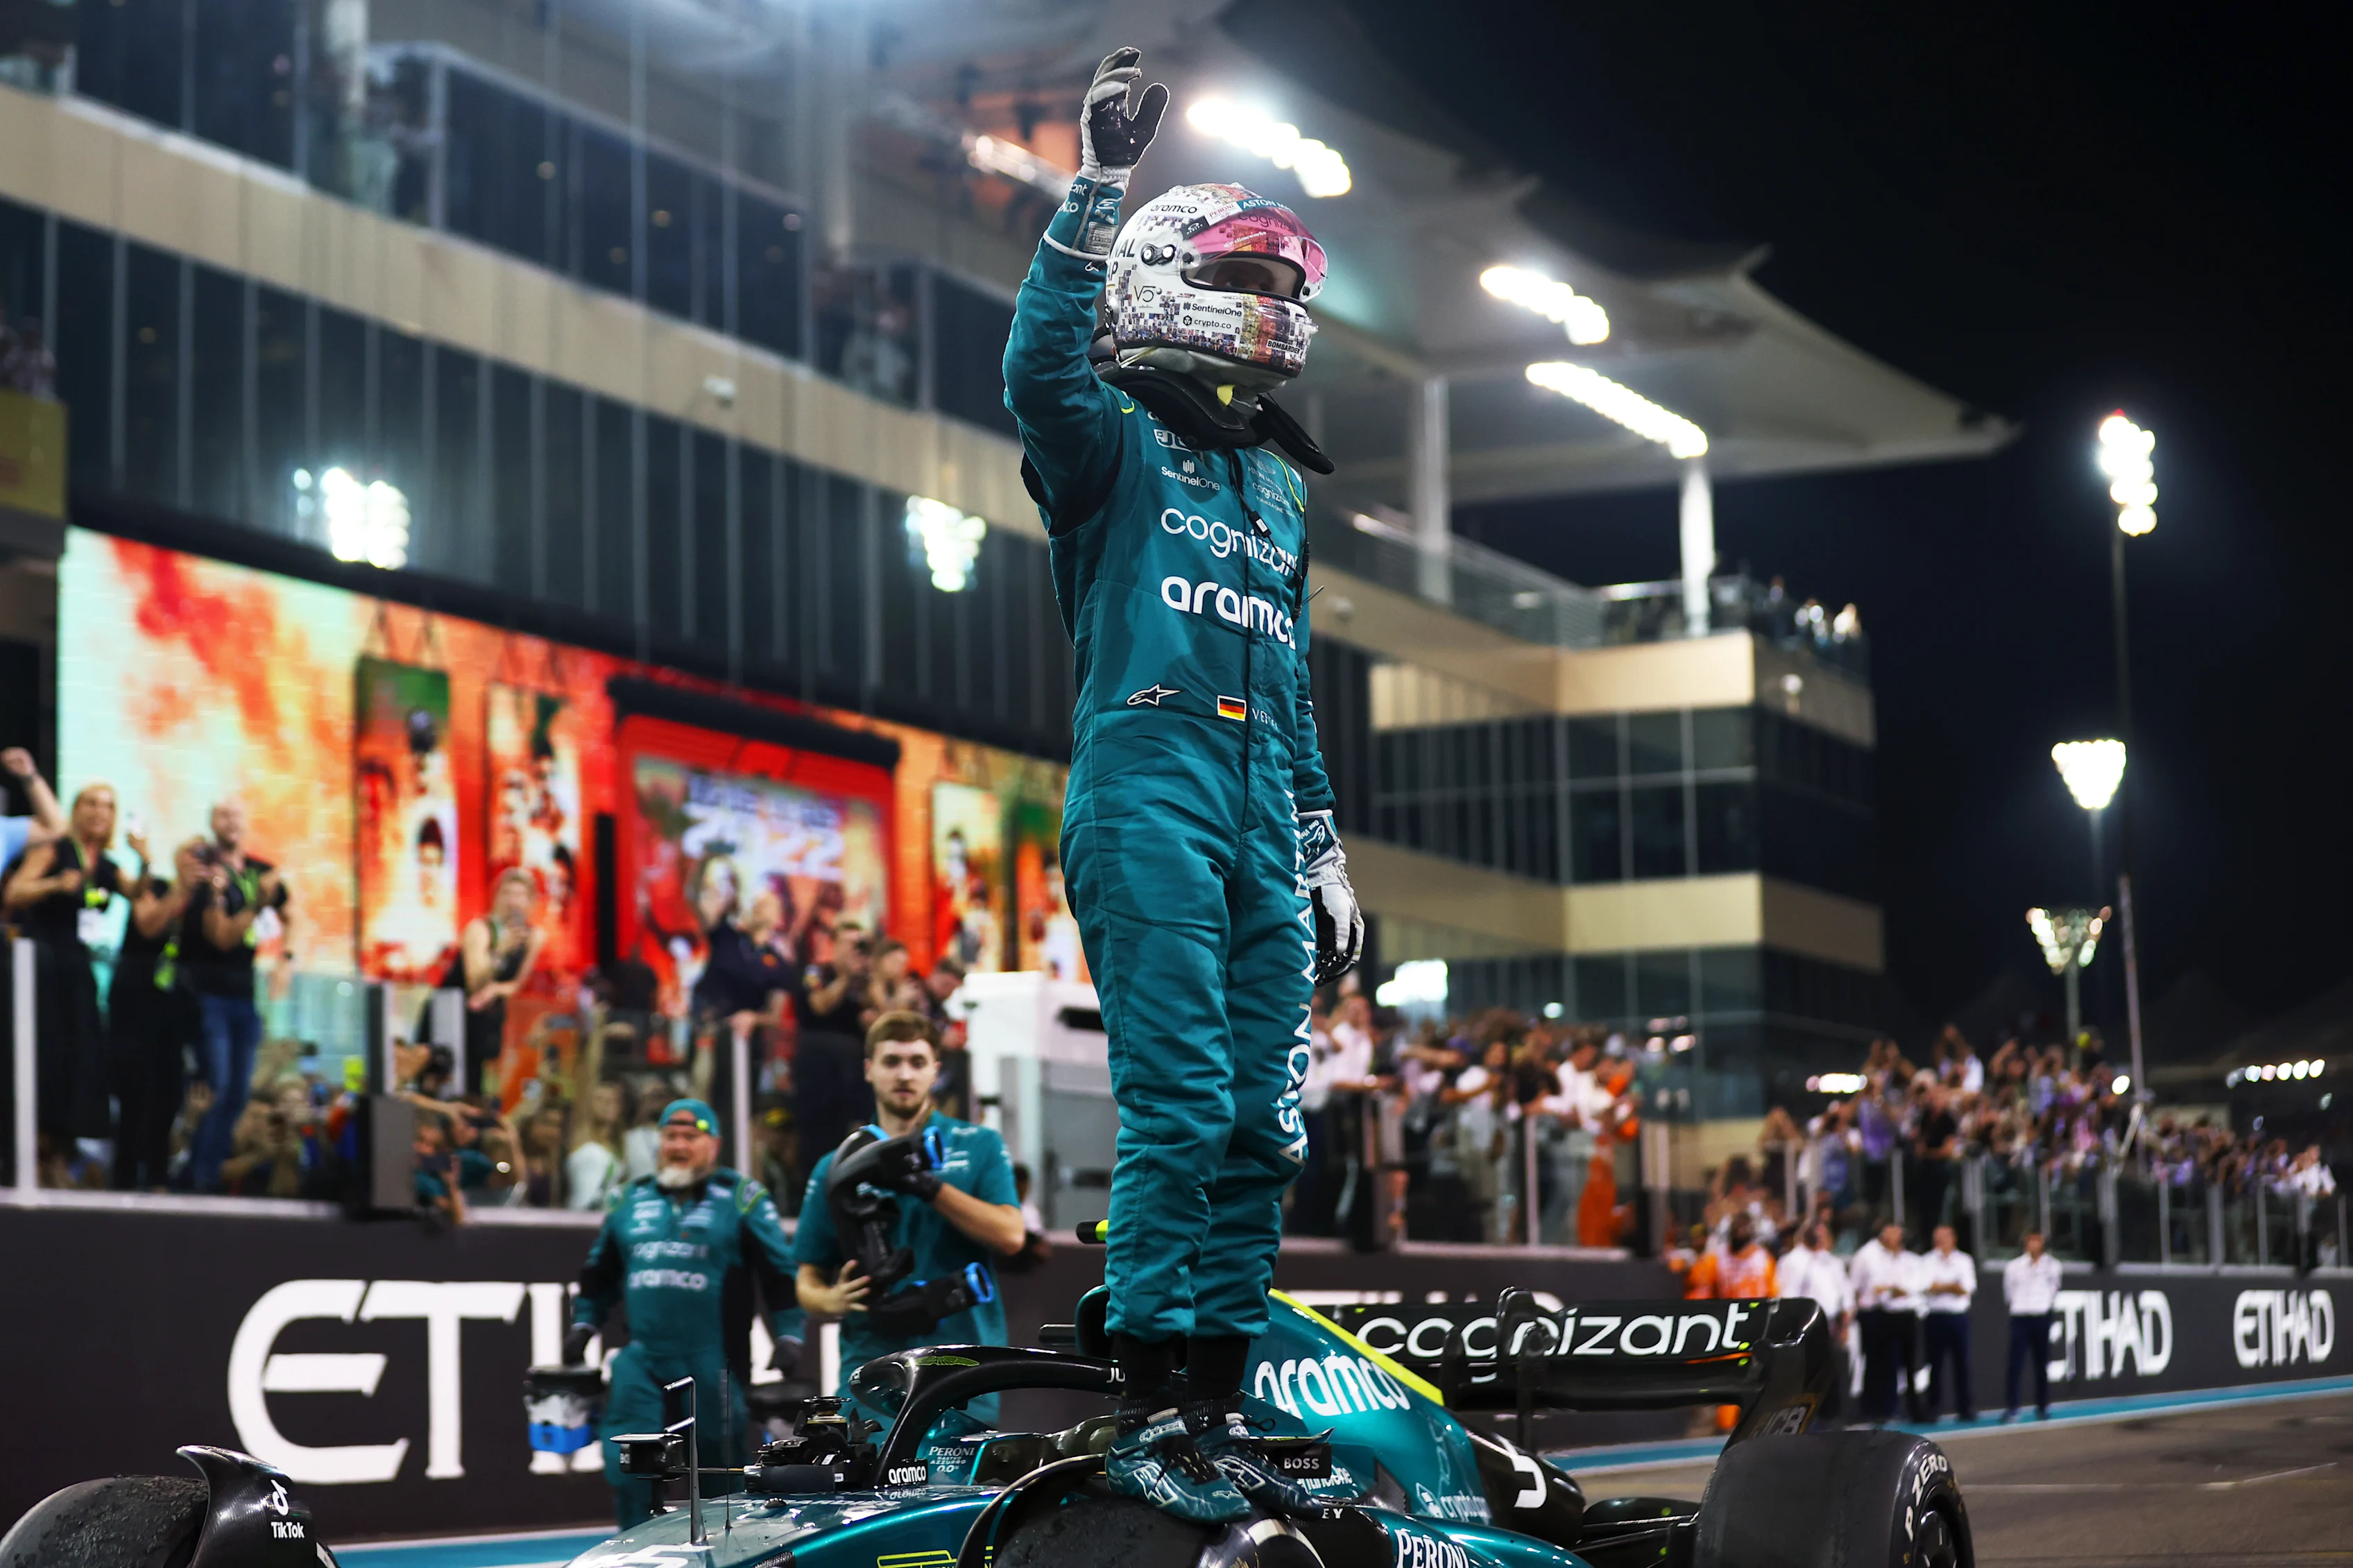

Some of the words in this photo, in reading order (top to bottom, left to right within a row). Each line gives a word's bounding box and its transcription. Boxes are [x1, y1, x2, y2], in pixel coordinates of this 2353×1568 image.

[1150, 204, 1197, 214] aramco
[1209, 204, 1234, 217] PERONI
[1242, 199, 1275, 209] ASTON
[1267, 341, 1300, 354] BOMBARDIER
[1161, 465, 1220, 491] SentinelOne
[1161, 508, 1299, 576] cognizan
[1278, 1003, 1312, 1169] ASTON
[2233, 1289, 2335, 1368] ETIHAD
[1254, 1355, 1411, 1420] aramco
[928, 1446, 975, 1456] PERONI
[1283, 1458, 1320, 1470] BOSS
[888, 1465, 927, 1484] aramco
[1912, 1454, 1948, 1507] ZERO
[271, 1522, 305, 1539] TikTok
[1394, 1528, 1470, 1568] PERONI
